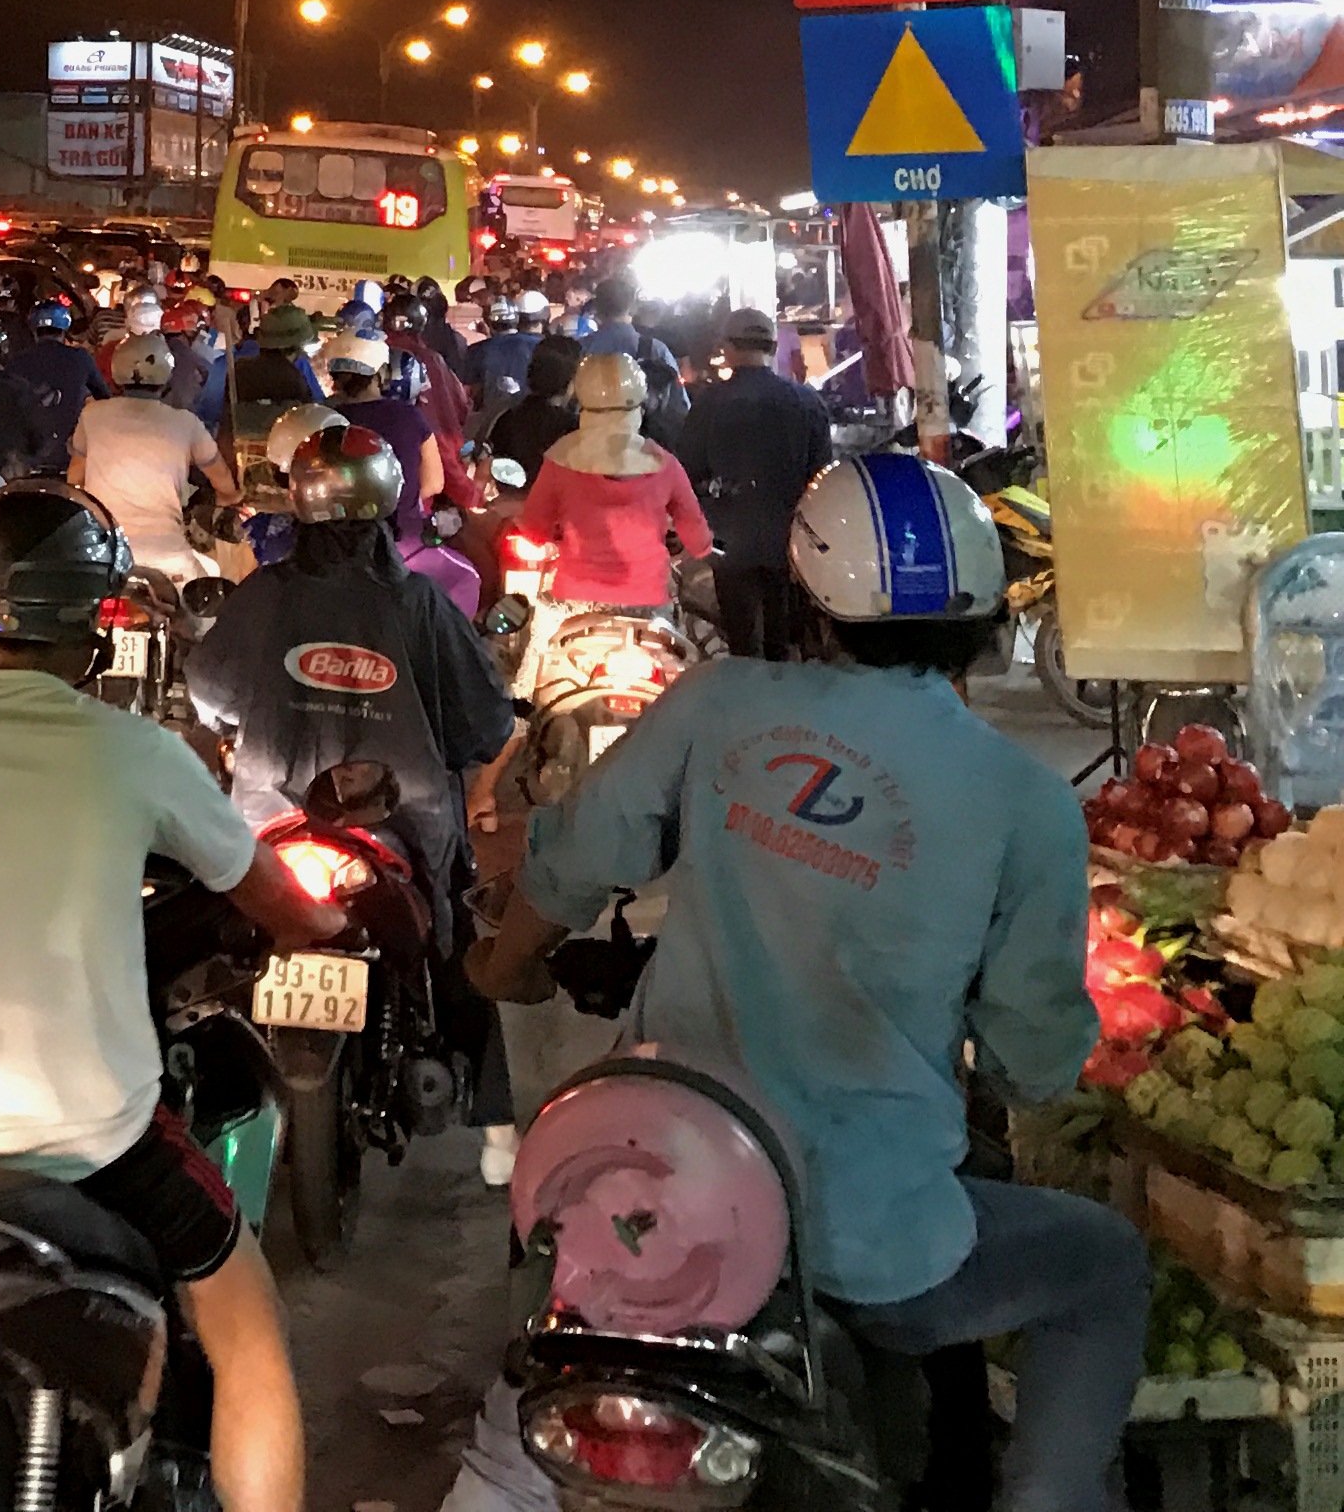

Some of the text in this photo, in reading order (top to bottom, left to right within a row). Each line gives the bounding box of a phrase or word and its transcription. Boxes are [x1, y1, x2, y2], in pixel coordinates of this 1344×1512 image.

[894, 163, 942, 197] CHỢ
[379, 191, 419, 228] 19
[308, 652, 389, 683] Barilla
[263, 989, 359, 1026] 117.92
